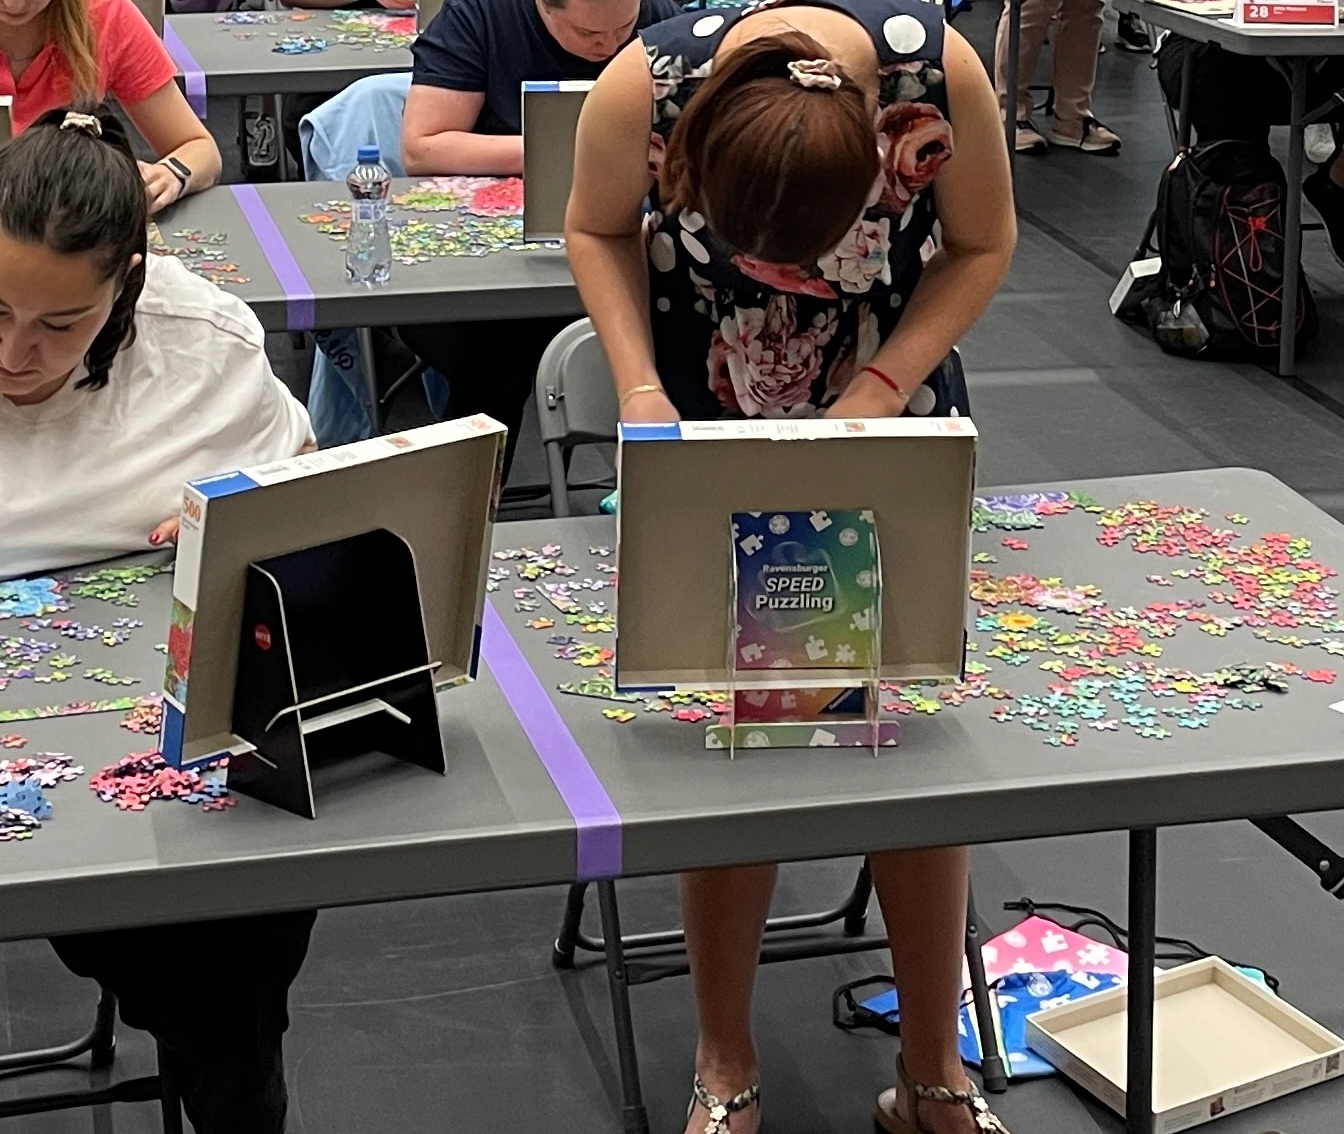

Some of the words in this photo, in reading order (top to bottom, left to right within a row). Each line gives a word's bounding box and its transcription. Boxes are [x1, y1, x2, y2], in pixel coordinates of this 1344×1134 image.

[1249, 5, 1269, 19] 28
[183, 495, 202, 523] 500
[765, 576, 825, 593] SPEED
[755, 593, 834, 612] Puzzling
